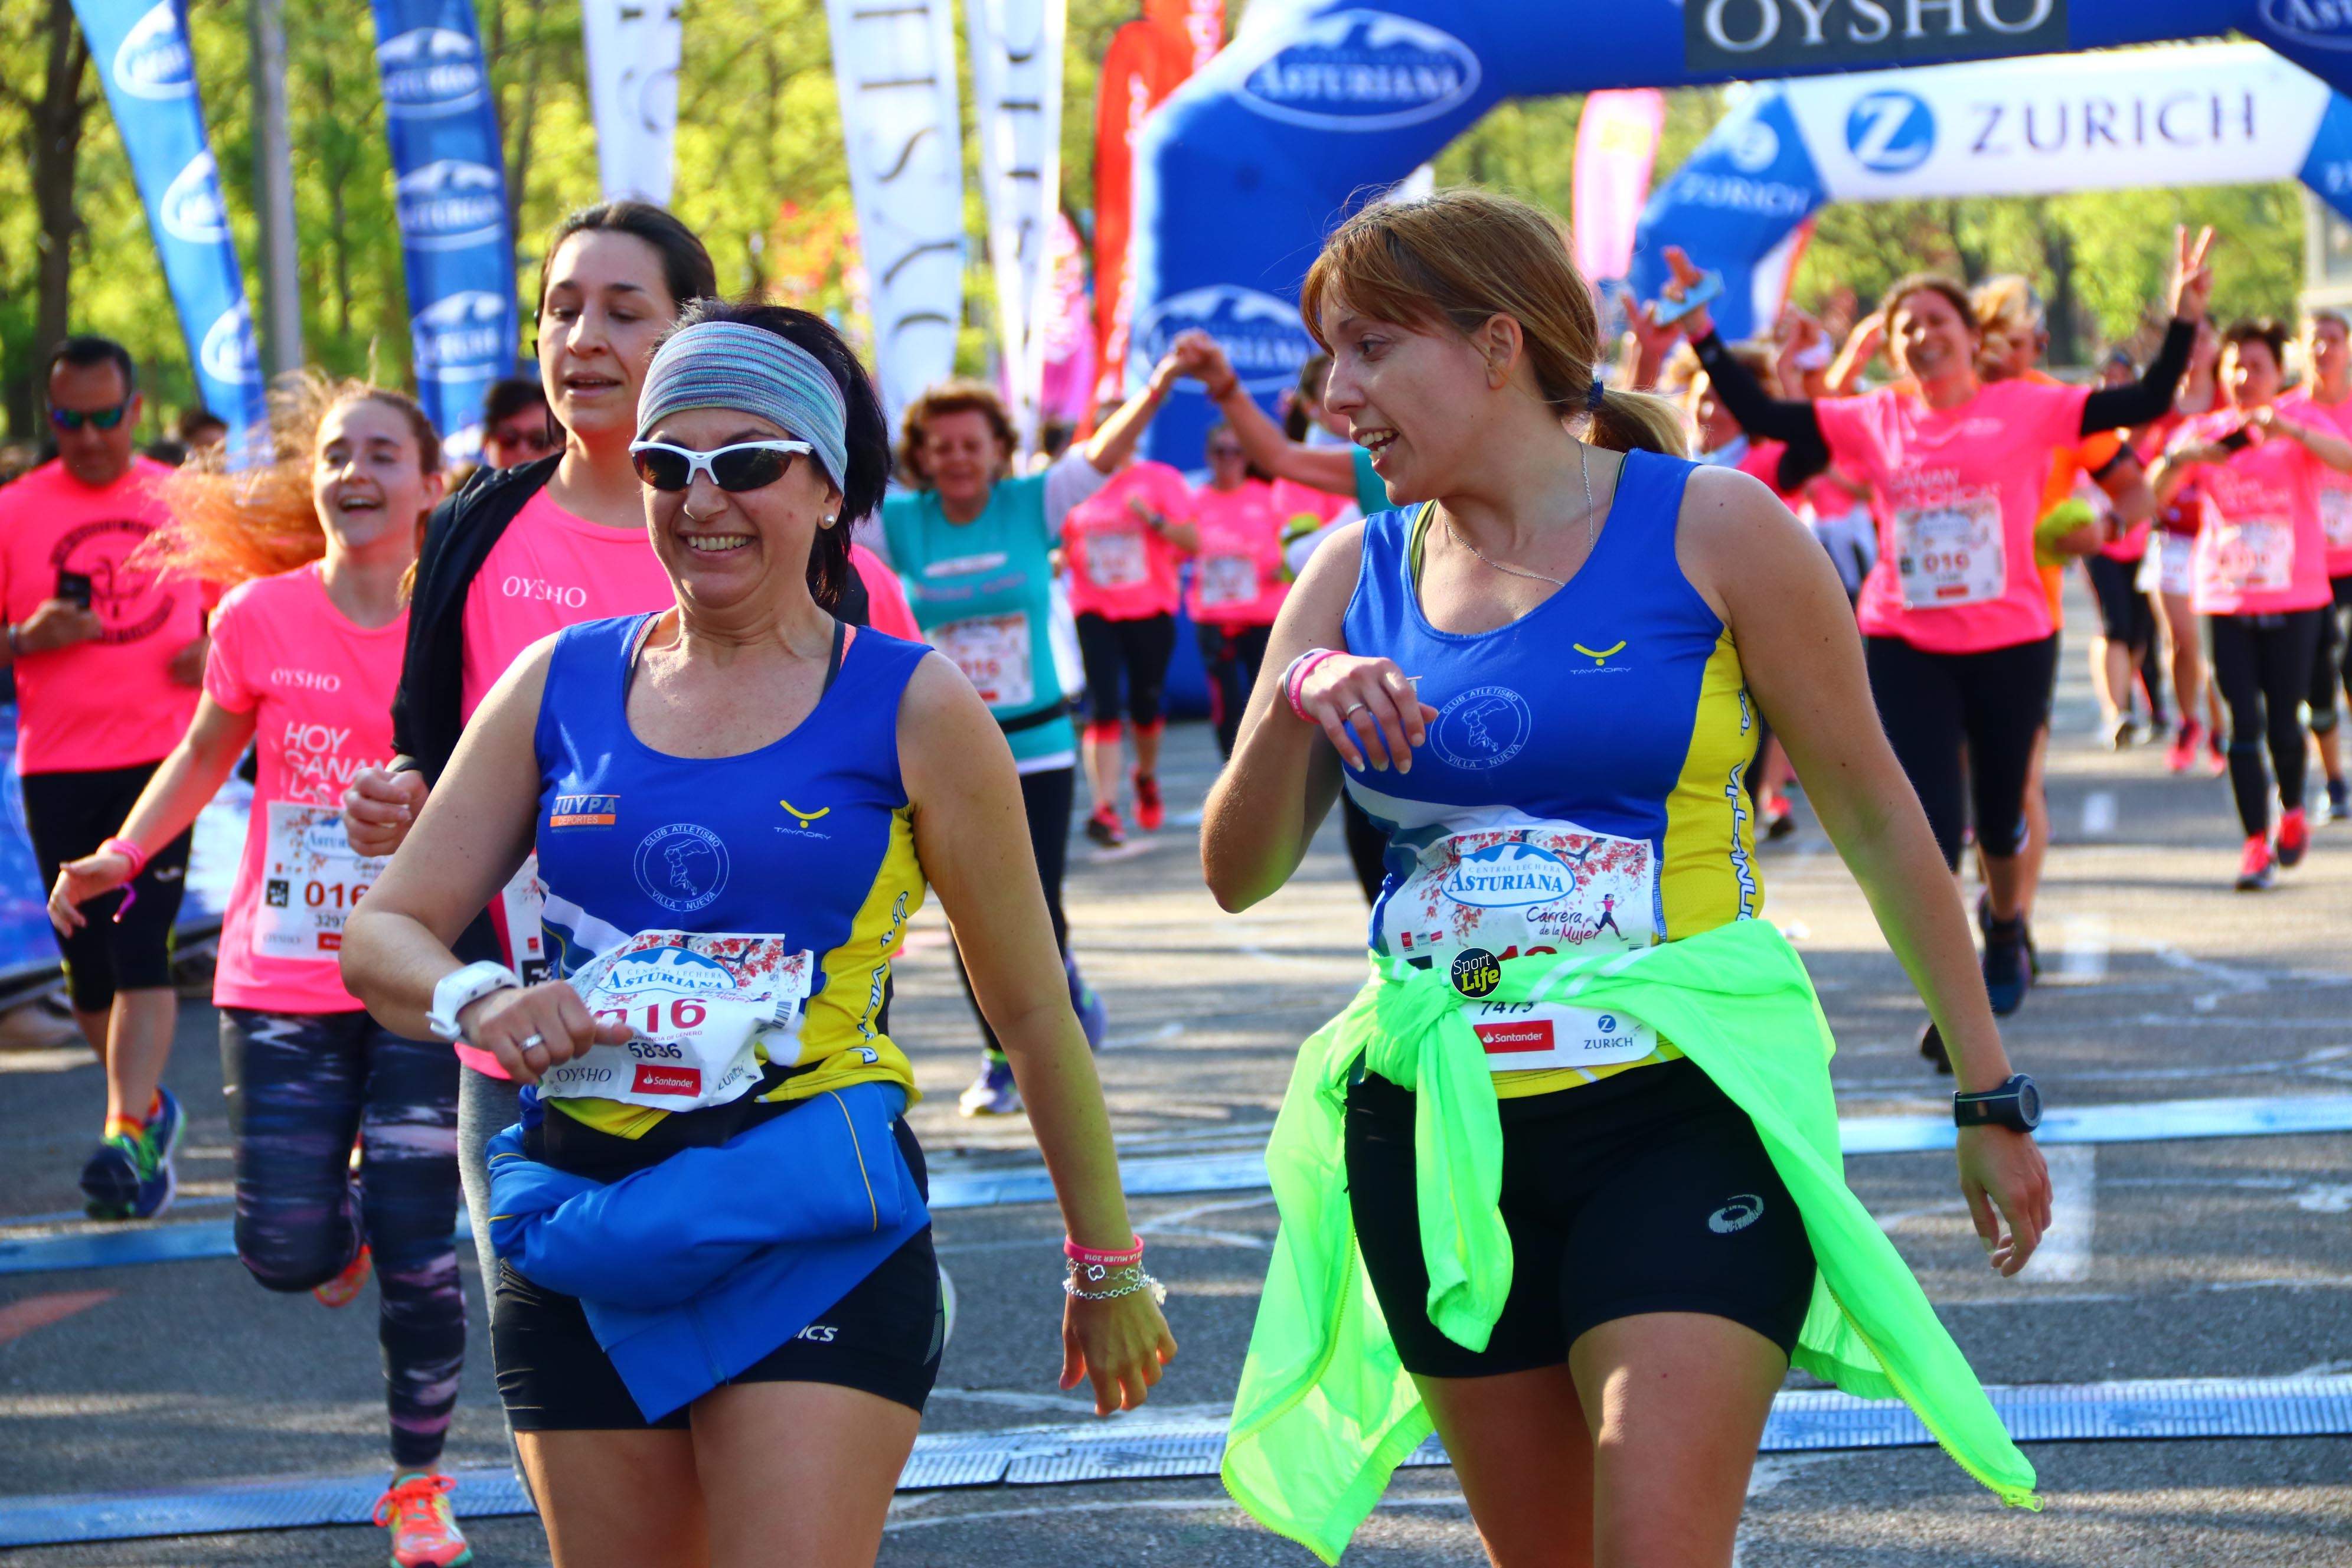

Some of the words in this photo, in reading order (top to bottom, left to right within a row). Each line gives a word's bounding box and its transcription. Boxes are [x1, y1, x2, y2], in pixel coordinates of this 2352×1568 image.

[1255, 57, 1459, 100] ASTURIANA
[1970, 92, 2254, 155] ZURICH
[502, 576, 587, 608] OYSHO
[271, 668, 340, 693] OYSHO
[1443, 695, 1466, 714] CLUB
[1469, 688, 1518, 702] ATLETISMO
[283, 721, 351, 754] HOY
[1448, 754, 1476, 769] VILLA
[1489, 743, 1521, 766] NUEVA
[285, 749, 384, 785] GANA
[552, 795, 616, 815] JUYPA
[558, 815, 598, 825] DEPORTES
[644, 828, 668, 847] CLUB
[672, 825, 720, 848] ATLETISMO
[774, 827, 831, 839] TAYMORY
[1469, 865, 1513, 873] CENTRAL
[1517, 863, 1561, 873] LECHERA
[1448, 869, 1564, 893] ASTURIANA
[652, 890, 676, 909] VILLA
[687, 891, 716, 910] NUEVA
[1526, 906, 1582, 925] Carrera
[1539, 925, 1550, 936] de
[1552, 924, 1560, 936] la
[1559, 924, 1602, 945] Mujer
[1453, 953, 1491, 975] Sport
[605, 970, 723, 989] ASTURIANA
[1461, 966, 1500, 992] Life
[1495, 1031, 1543, 1043] Santander
[1584, 1037, 1634, 1049] ZURICH
[628, 1041, 682, 1059] 5836
[556, 1067, 612, 1083] OYSHO
[654, 1076, 694, 1089] Santander
